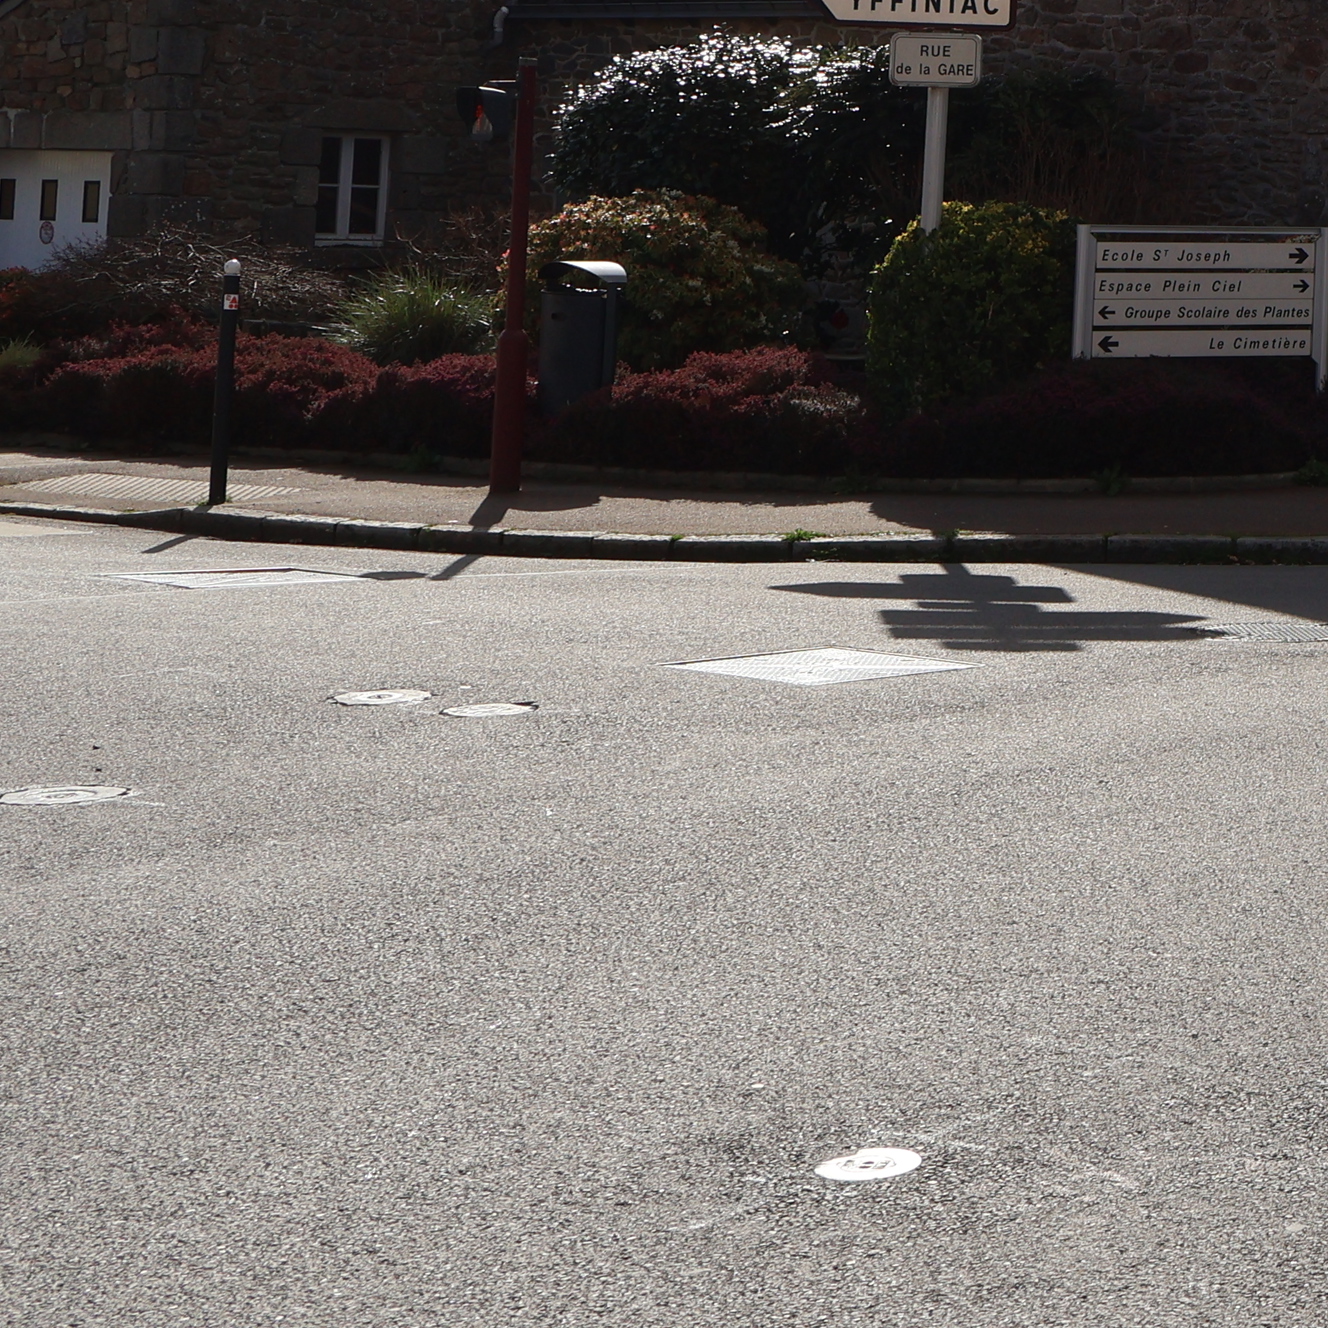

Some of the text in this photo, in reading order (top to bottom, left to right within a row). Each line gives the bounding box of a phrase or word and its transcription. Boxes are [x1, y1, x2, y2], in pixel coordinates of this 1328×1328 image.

[920, 44, 951, 58] RUE
[896, 62, 973, 77] de la GARE
[1101, 249, 1144, 262] Ecole
[1177, 249, 1231, 264] Joseph
[1099, 280, 1242, 294] Espace Plein Ciel
[1124, 306, 1310, 321] Groupe Scolaire des Plantes
[1209, 337, 1306, 350] Le Cimetière
